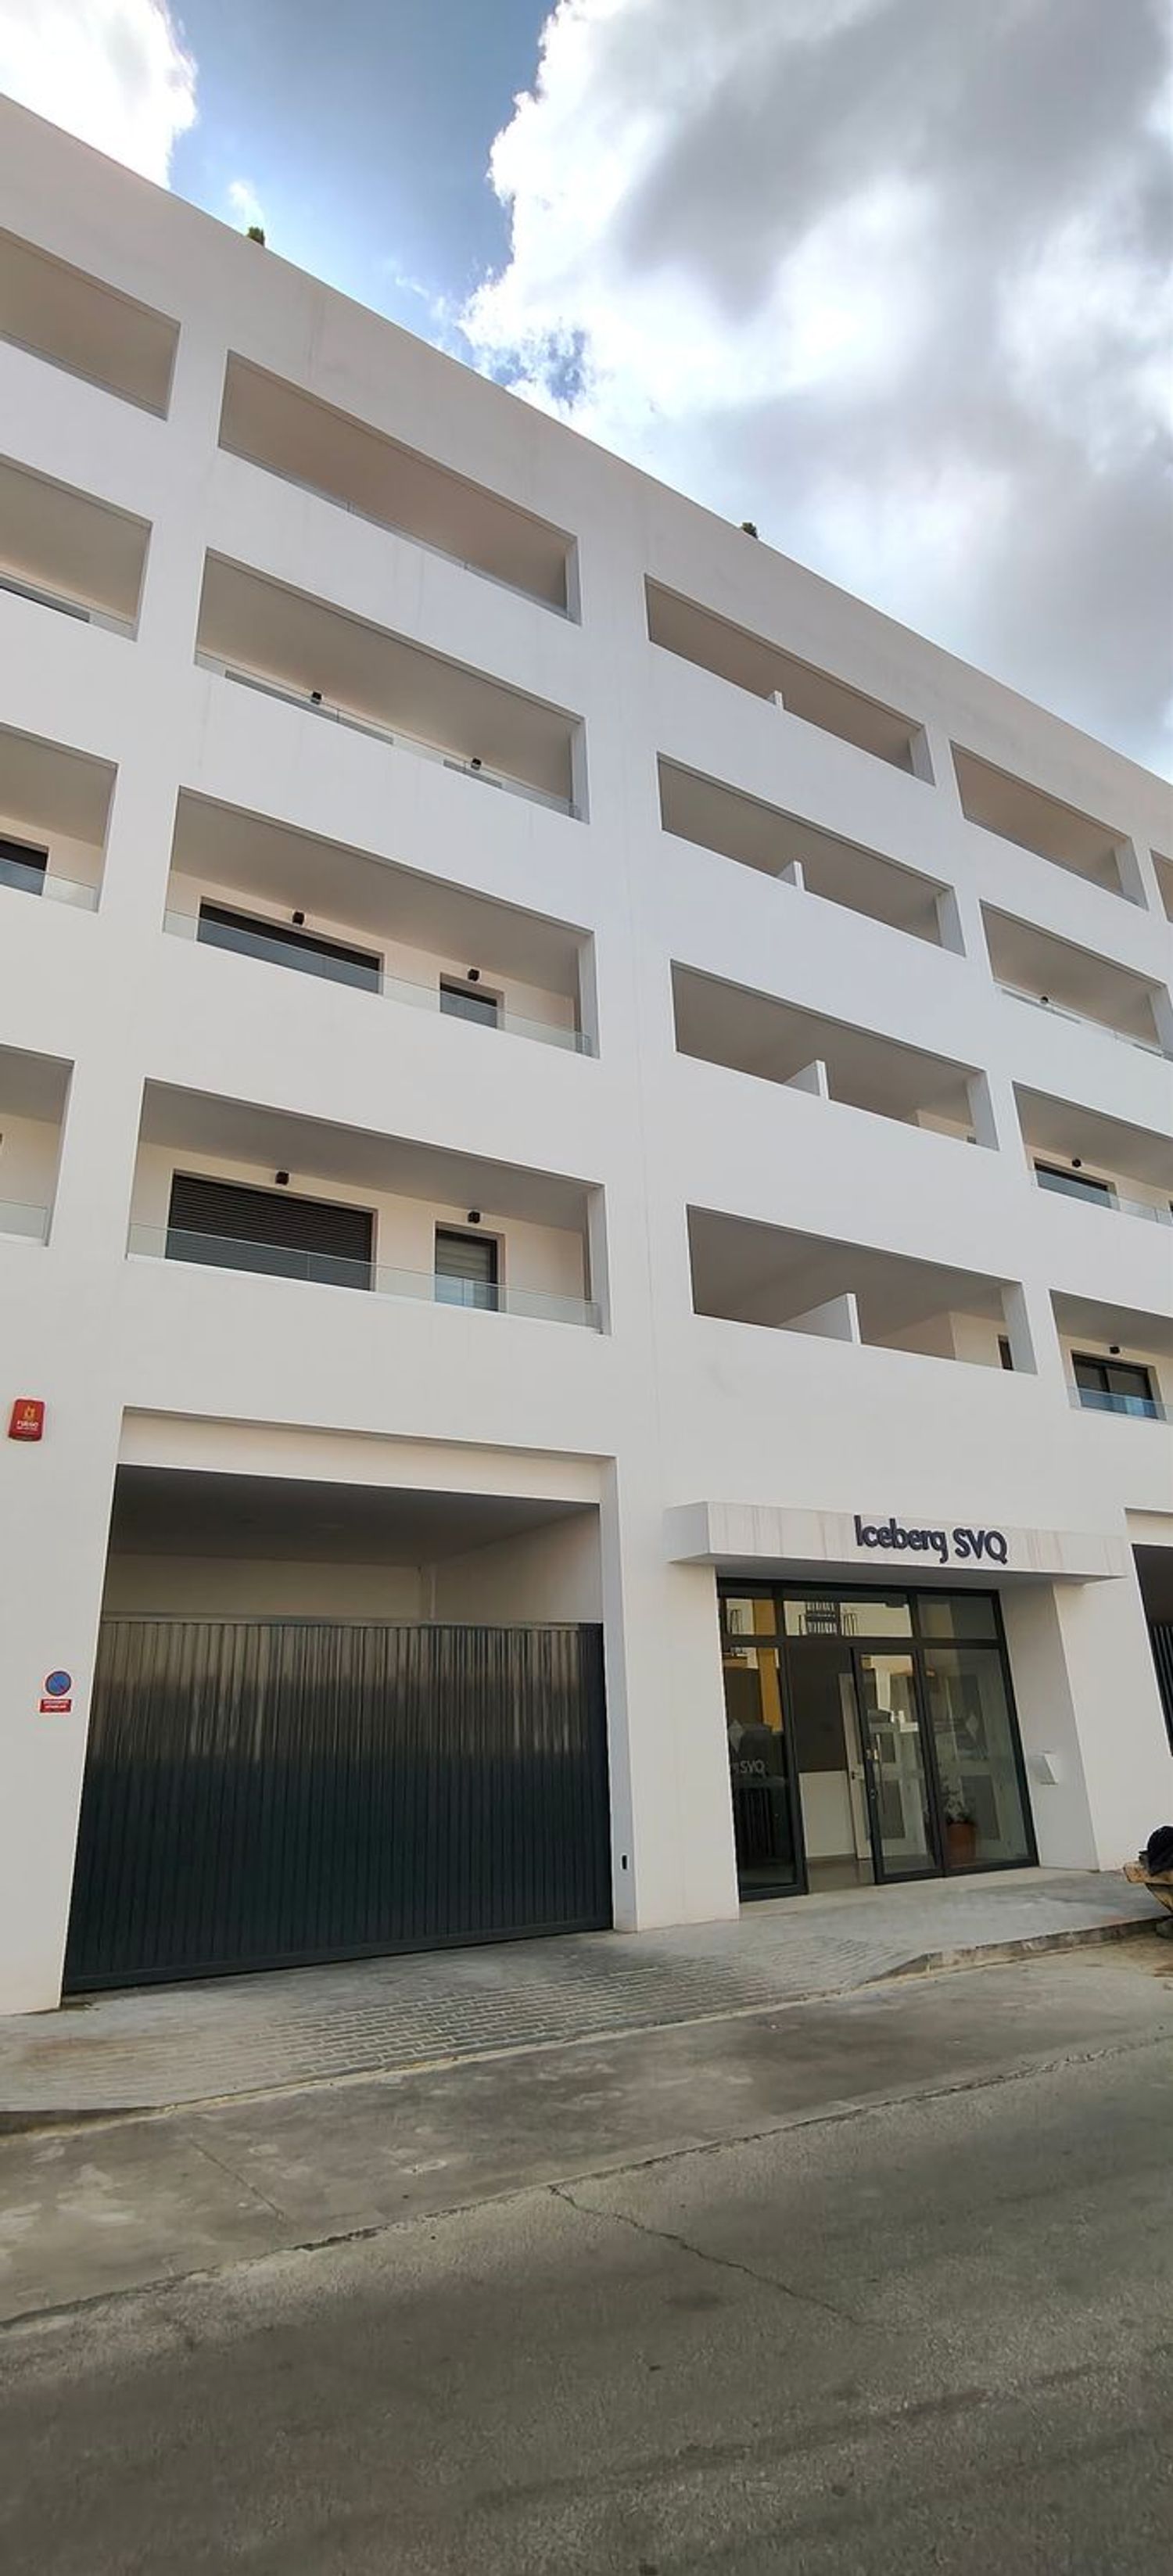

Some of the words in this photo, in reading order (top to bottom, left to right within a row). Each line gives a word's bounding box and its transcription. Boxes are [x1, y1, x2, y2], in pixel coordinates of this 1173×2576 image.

[854, 1515, 949, 1563] Iceberg
[952, 1527, 1007, 1564] SVQ
[740, 1760, 766, 1776] SVQ
